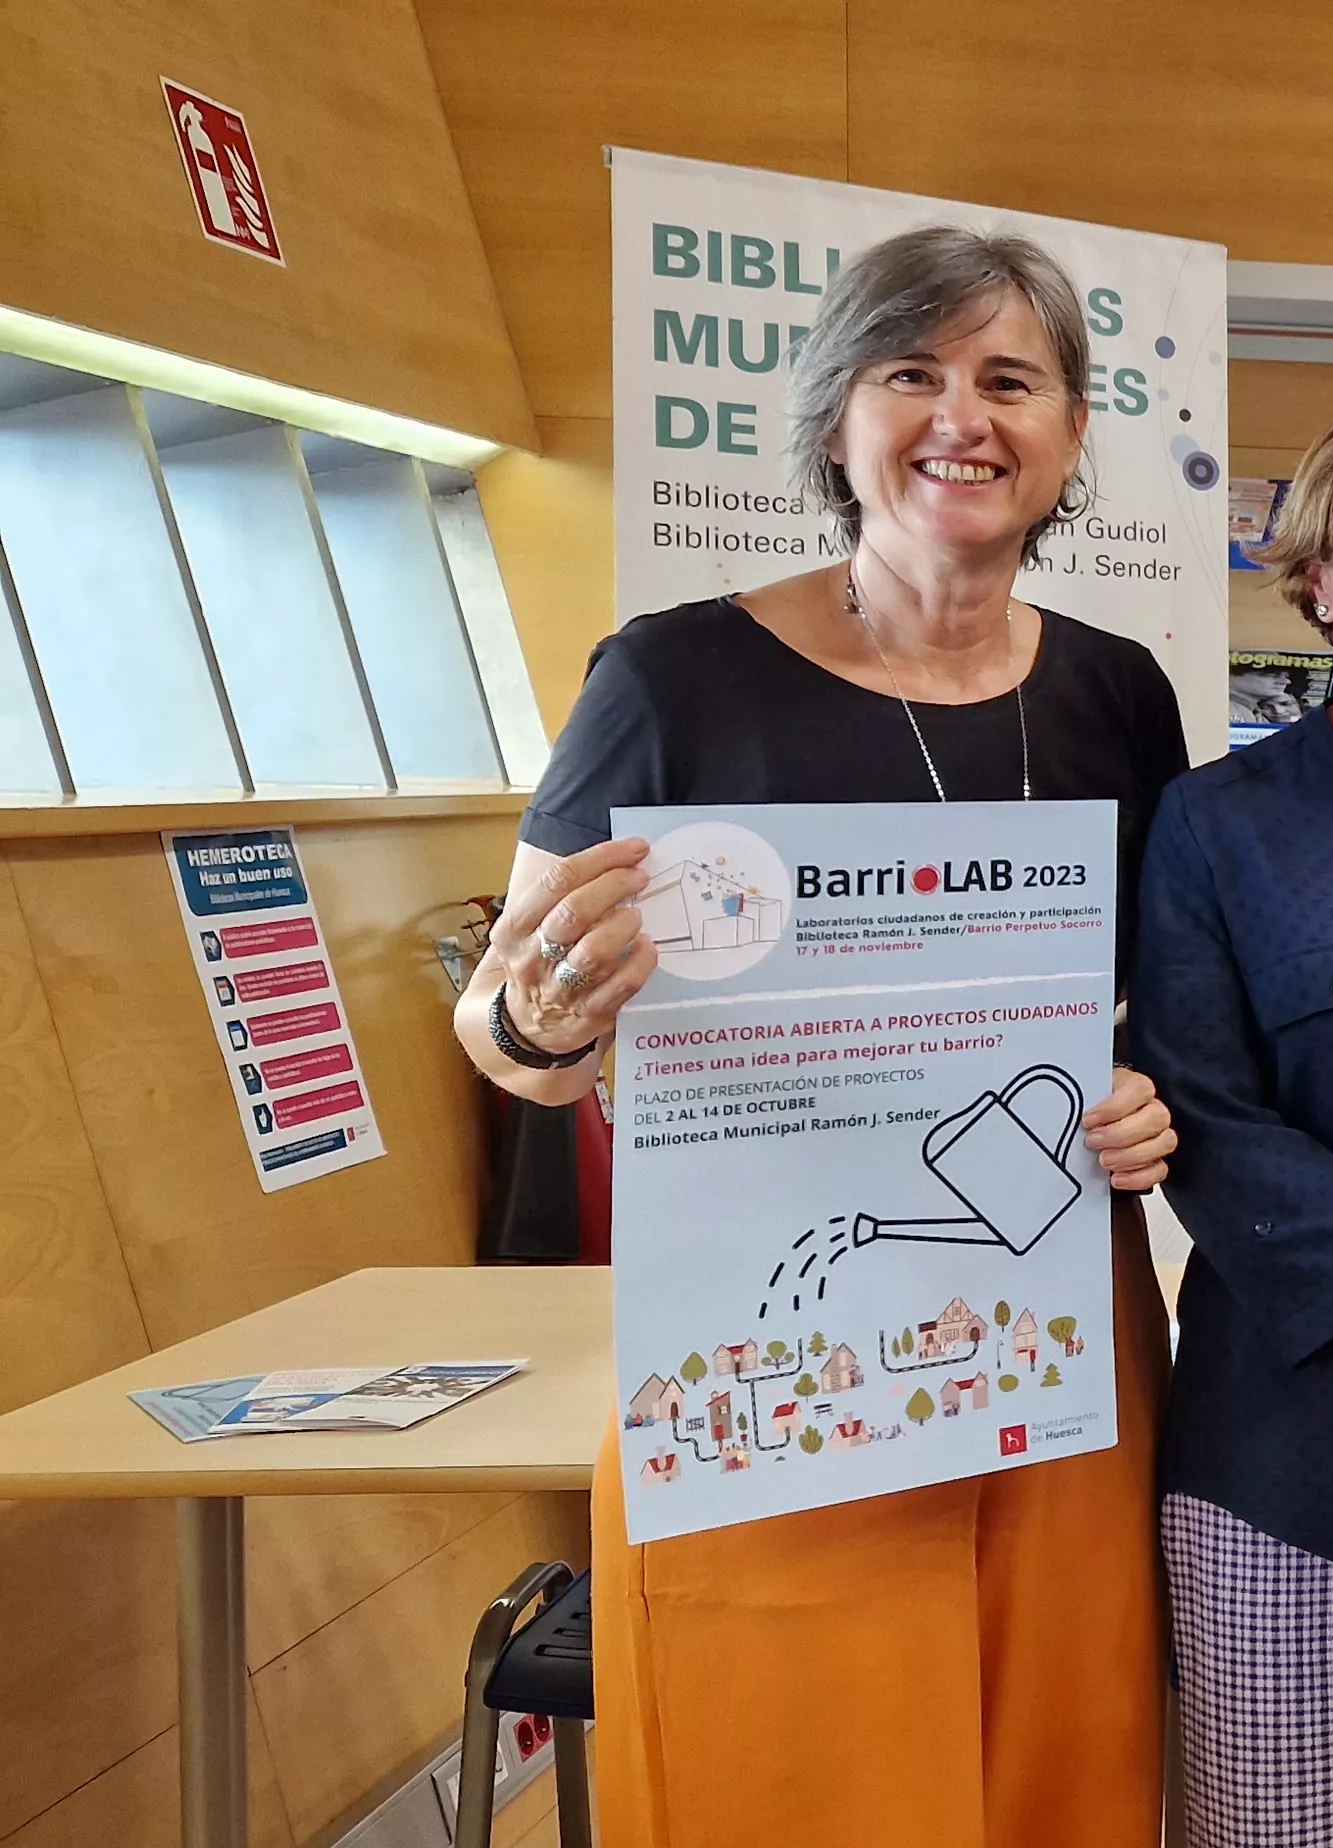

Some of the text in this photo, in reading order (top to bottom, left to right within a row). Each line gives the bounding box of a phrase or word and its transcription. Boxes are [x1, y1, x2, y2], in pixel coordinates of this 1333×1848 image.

[655, 394, 758, 456] DE
[653, 480, 804, 515] Biblioteca
[1085, 517, 1166, 544] Gudiol
[653, 522, 805, 555] Biblioteca
[1064, 553, 1084, 575] J.
[1095, 555, 1182, 581] Sender
[1230, 652, 1333, 669] togramas
[187, 843, 293, 867] HEMEROTECA
[199, 866, 292, 887] Haz un buen uso
[1023, 864, 1086, 888] 2023
[796, 905, 1101, 929] Laboratorios ciudadanos de creación y participación
[796, 918, 1102, 942] Biblioteca Ramón J. Sender/Barrio Perpetuo Socorro
[796, 940, 924, 957] 17 y 18 de noviembre
[635, 1001, 1098, 1050] CONVOCATORIA ABIERTA A PROYECTOS CIUDADANOS
[634, 1034, 1003, 1081] ¿Tienes una idea para mejorar tu barrio?
[634, 1068, 925, 1105] PLAZO DE PRESENTACIÓN DE PROYECTOS
[634, 1097, 817, 1126] DEL 2 AL 14 DE OCTUBRE
[634, 1107, 941, 1149] Biblioteca Municipal Ramón J. Sender
[1031, 1411, 1099, 1433] Ayuntamiento
[1045, 1426, 1083, 1440] Huesca
